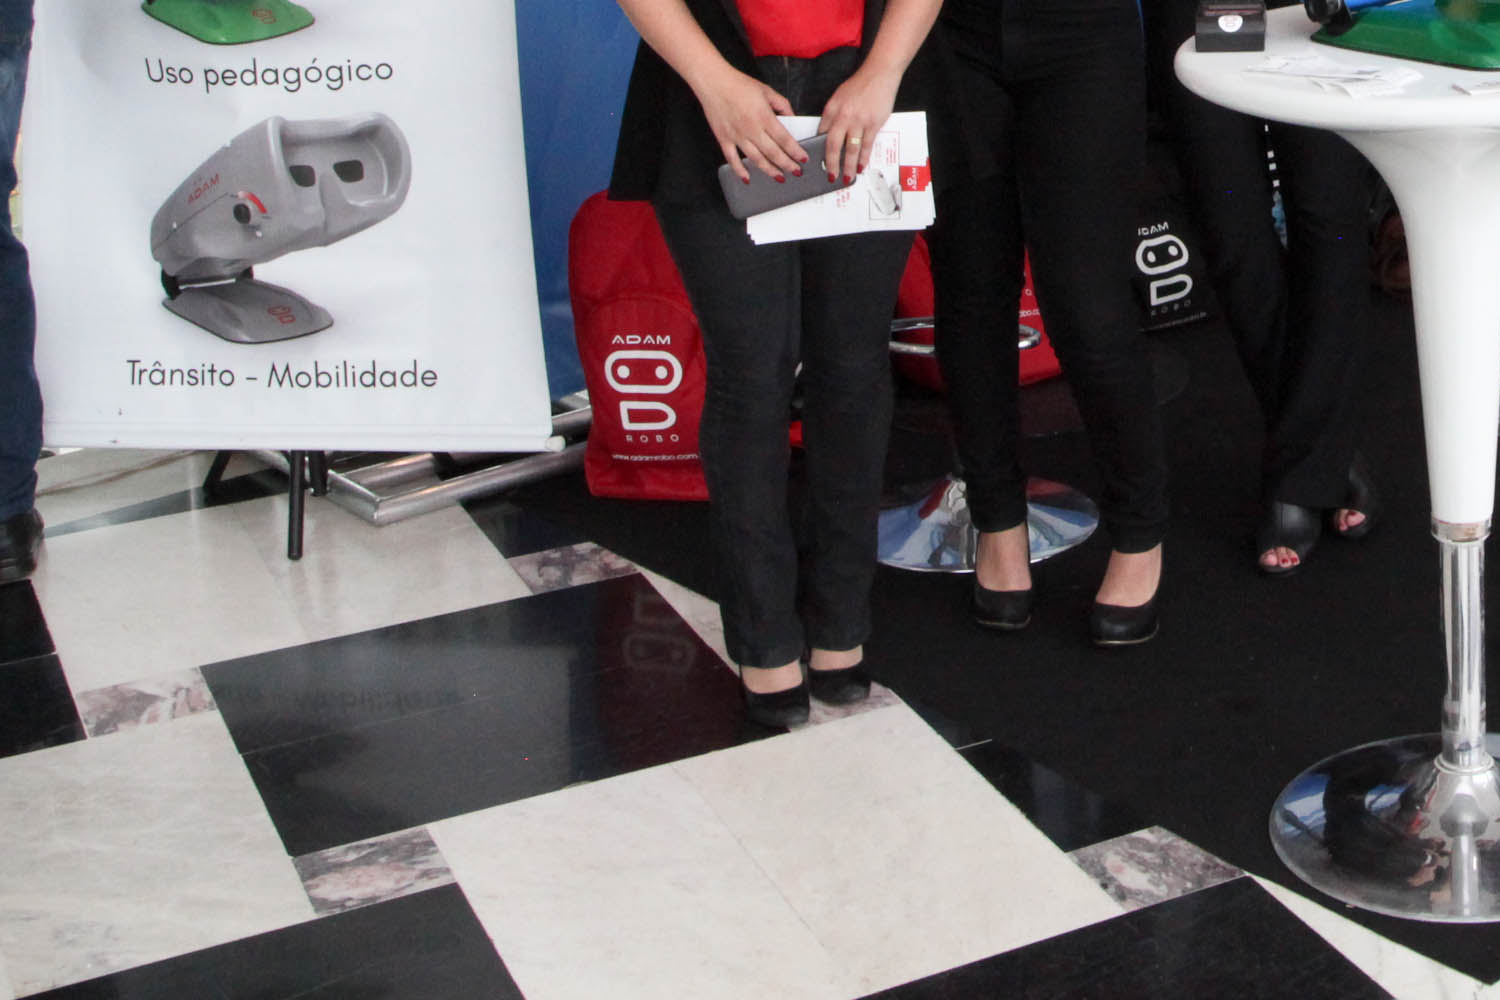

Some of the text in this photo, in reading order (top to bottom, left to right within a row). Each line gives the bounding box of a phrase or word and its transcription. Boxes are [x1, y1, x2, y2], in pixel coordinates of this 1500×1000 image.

[144, 57, 394, 94] Uso pedagógico
[612, 335, 671, 345] ADAM
[126, 359, 236, 388] Trânsito
[267, 358, 439, 388] Mobilidade
